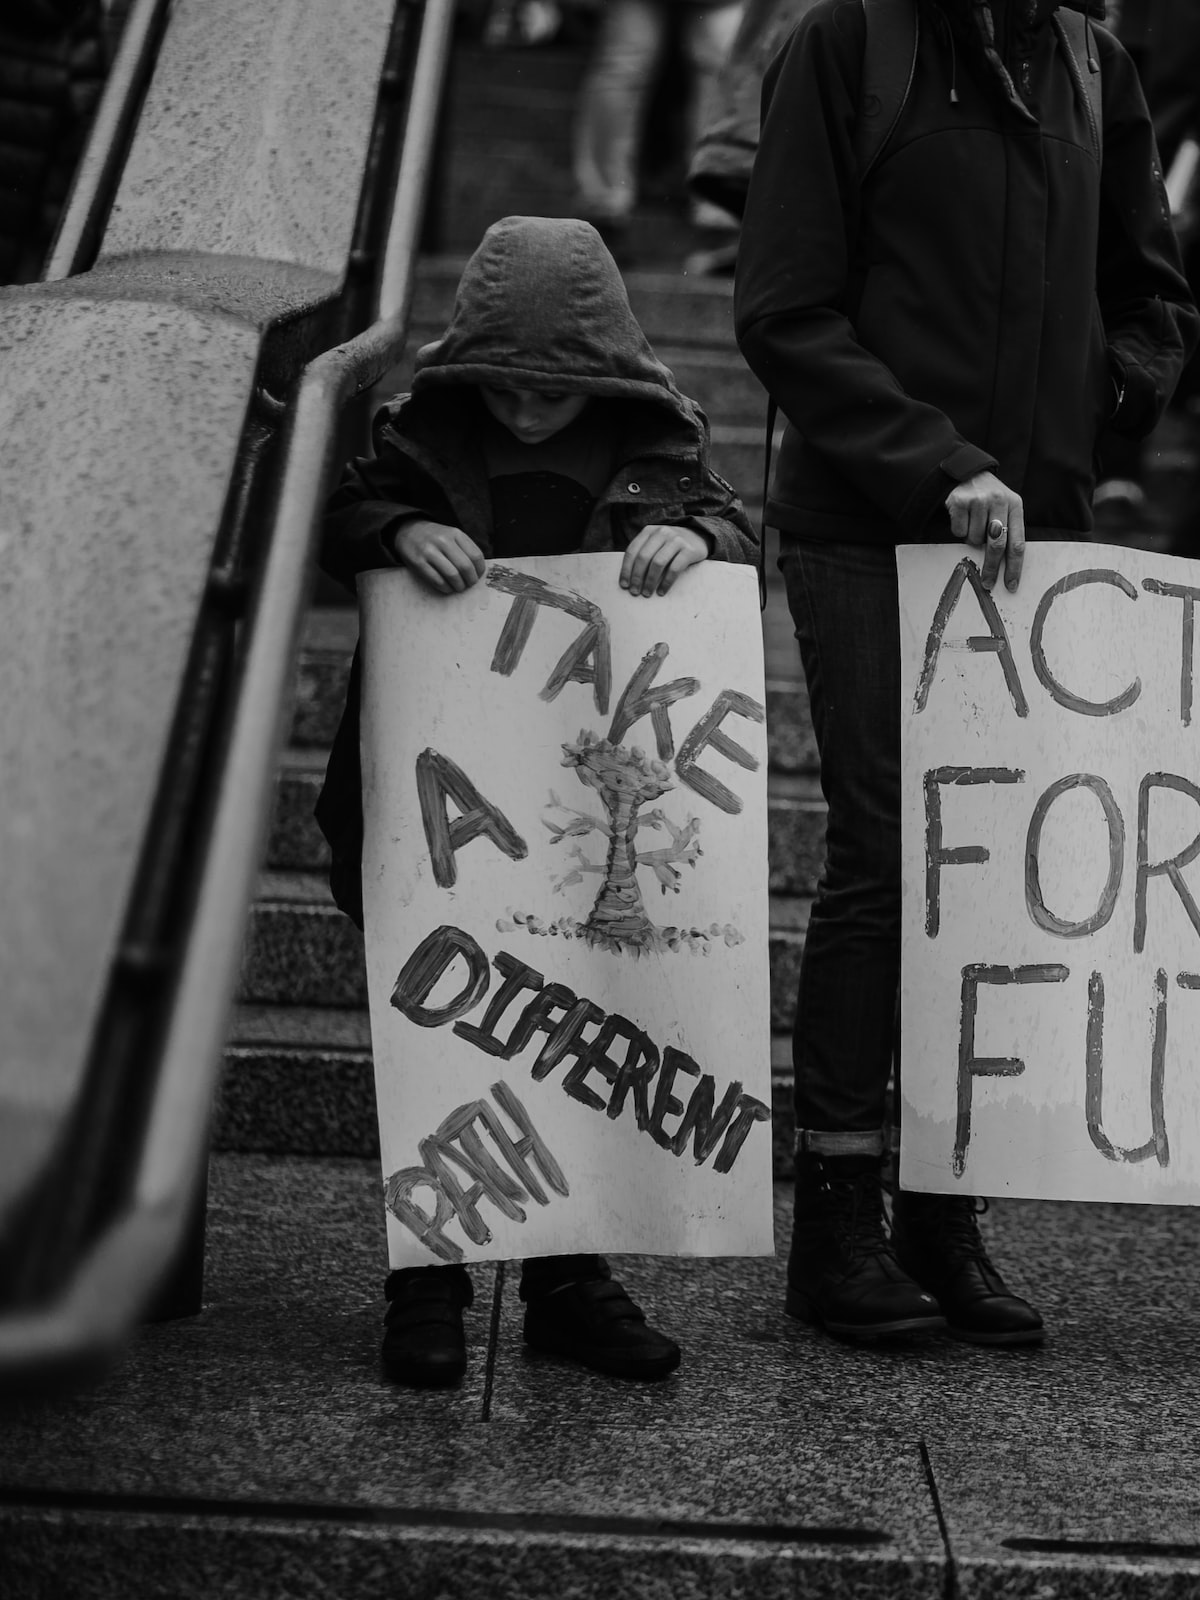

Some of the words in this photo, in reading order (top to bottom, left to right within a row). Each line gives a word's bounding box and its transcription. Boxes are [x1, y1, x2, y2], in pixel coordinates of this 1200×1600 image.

[485, 563, 764, 814] TAKE
[415, 747, 528, 888] A
[390, 925, 772, 1174] DIFFERENT
[384, 1080, 570, 1262] PATH
